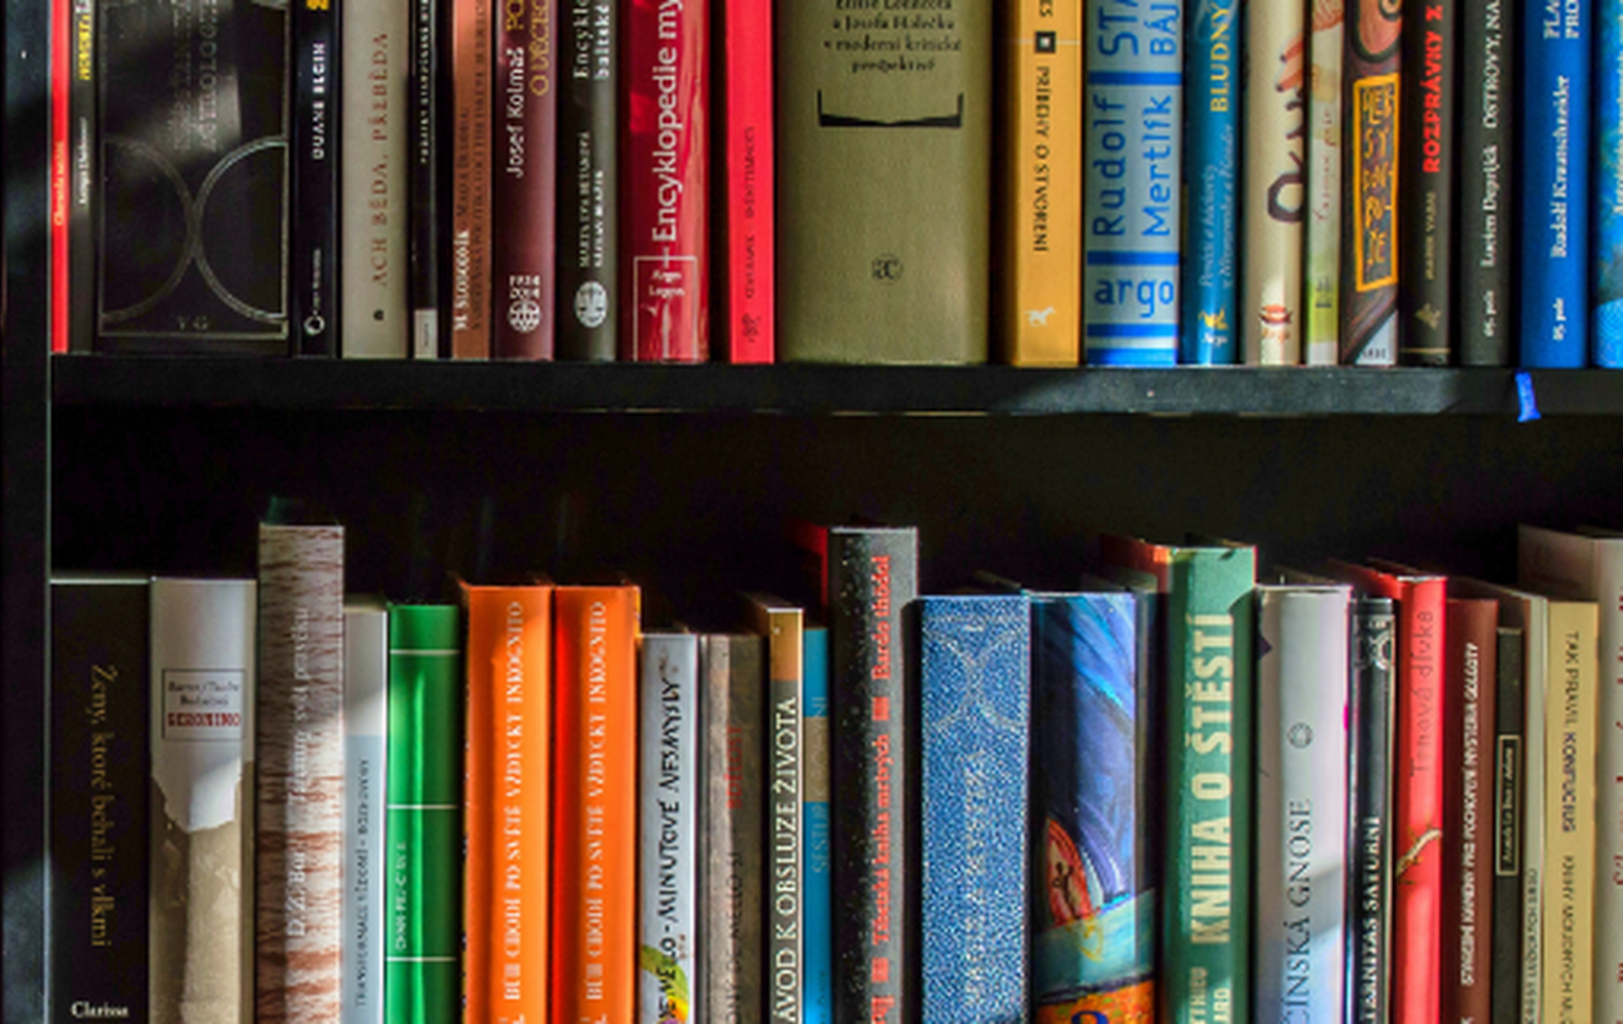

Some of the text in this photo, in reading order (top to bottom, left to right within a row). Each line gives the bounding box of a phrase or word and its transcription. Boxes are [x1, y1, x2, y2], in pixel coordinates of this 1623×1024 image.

[311, 42, 326, 160] DUANE ELGIN
[504, 46, 525, 119] Kolmaš
[1204, 1, 1230, 113] BLUDNÝ
[1420, 30, 1443, 173] ROZPRÁVKY
[506, 124, 525, 179] Josef
[651, 47, 684, 242] Encyklopedie
[1091, 92, 1127, 237] Rudolf
[1140, 94, 1172, 237] Mertlík
[372, 235, 389, 288] ACH
[1550, 199, 1569, 258] Rudolf
[1091, 278, 1176, 320] argo
[504, 601, 524, 703] INKOGNITO
[586, 601, 607, 703] INKOGNITO
[871, 621, 891, 680] Bardo
[1566, 630, 1580, 665] TAK
[771, 696, 798, 795] ŽIVOTA
[872, 734, 894, 807] mrtvých
[1183, 613, 1233, 944] KNIHA O ŠTĚSTÍ
[1561, 732, 1577, 834] KONFUCIUS
[85, 663, 119, 947] Ženy, ktoré behali s vlkmi
[872, 811, 890, 866] kniha
[1286, 798, 1311, 908] GNOSE
[504, 865, 523, 891] PO
[586, 865, 604, 891] PO
[776, 802, 798, 916] OBSLUZE
[871, 868, 892, 946] Tibetská
[776, 921, 798, 941] K
